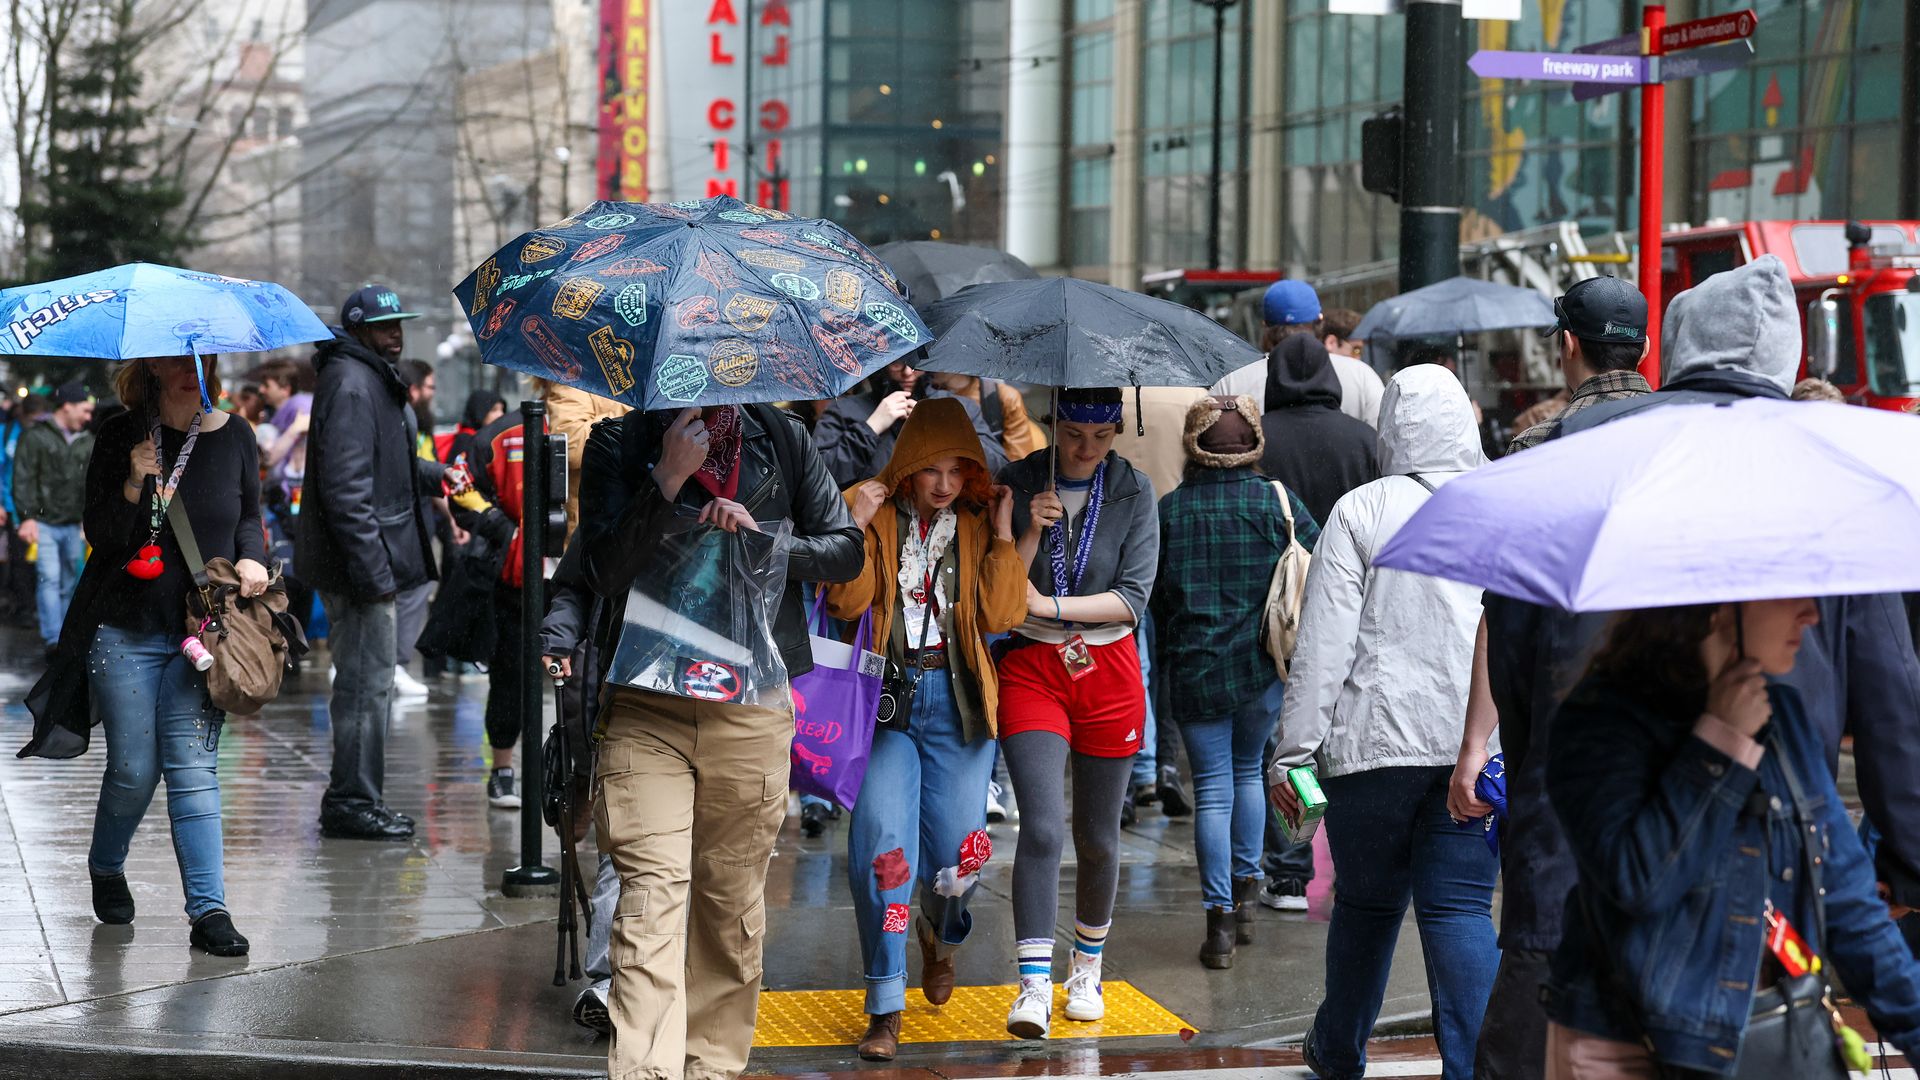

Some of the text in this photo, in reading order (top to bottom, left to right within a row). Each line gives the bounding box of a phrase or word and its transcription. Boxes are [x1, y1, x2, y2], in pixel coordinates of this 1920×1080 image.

[707, 0, 738, 64] AL
[1662, 20, 1736, 47] map & information
[1543, 57, 1634, 80] freeway park
[612, 361, 632, 389] SPRINGS
